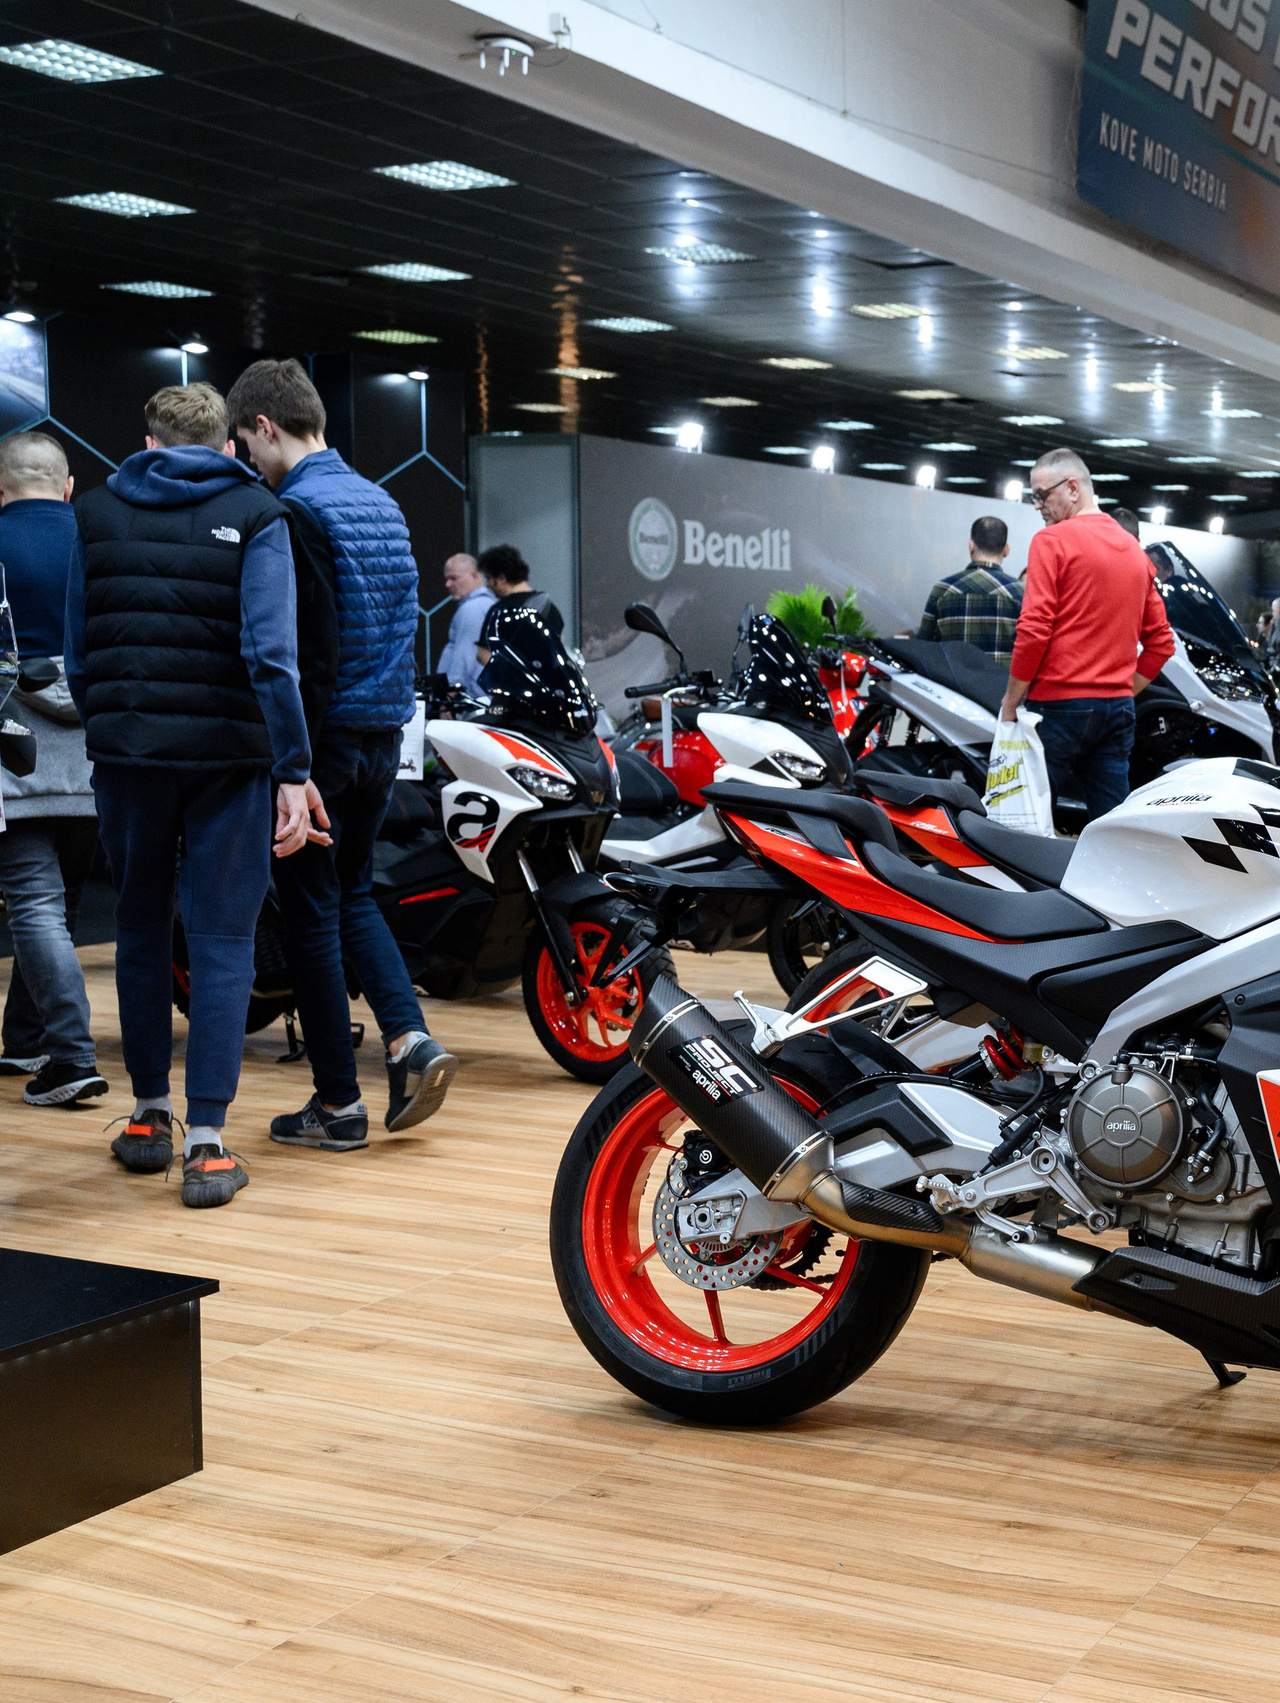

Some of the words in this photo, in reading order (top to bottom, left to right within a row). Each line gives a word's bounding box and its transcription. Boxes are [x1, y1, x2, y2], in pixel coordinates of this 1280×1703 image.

[1100, 112, 1138, 162] KOVE
[1143, 137, 1179, 184] MOTO
[1183, 160, 1227, 211] SERBIA
[683, 519, 791, 571] Benelli
[685, 1042, 738, 1095] PROJECT
[691, 1039, 758, 1093] SC
[692, 1069, 721, 1101] aprilia
[1106, 1120, 1136, 1132] aprilia
